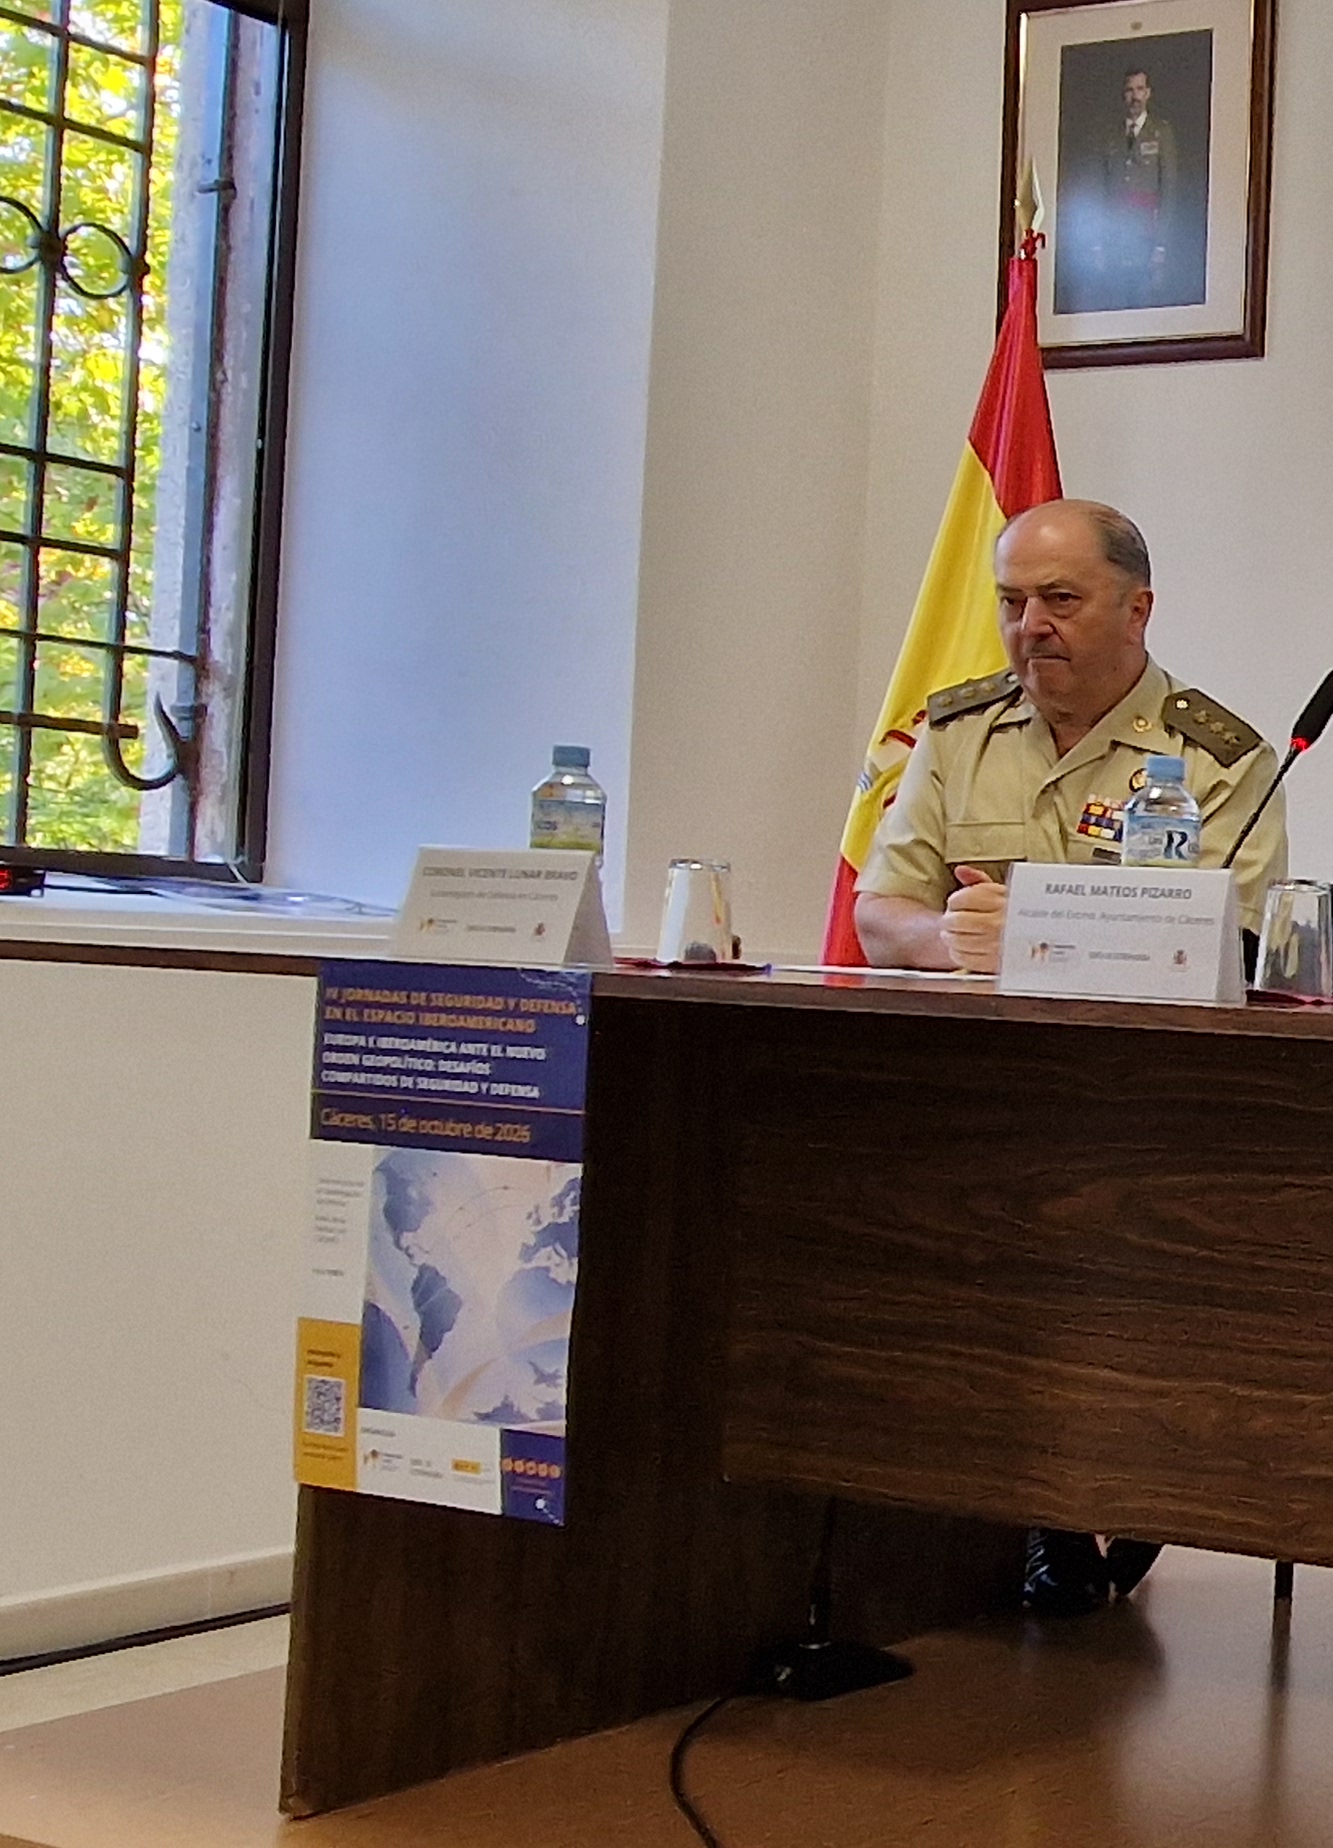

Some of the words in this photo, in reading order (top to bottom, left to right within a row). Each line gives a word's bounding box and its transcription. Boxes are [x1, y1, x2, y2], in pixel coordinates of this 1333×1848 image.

[1045, 884, 1086, 896] RAFAEL
[1090, 885, 1138, 898] MATEOS
[1141, 887, 1193, 900] PIZARRO
[380, 1113, 396, 1131] 15
[399, 1115, 418, 1133] de
[419, 1117, 473, 1138] octubre
[475, 1122, 494, 1139] de
